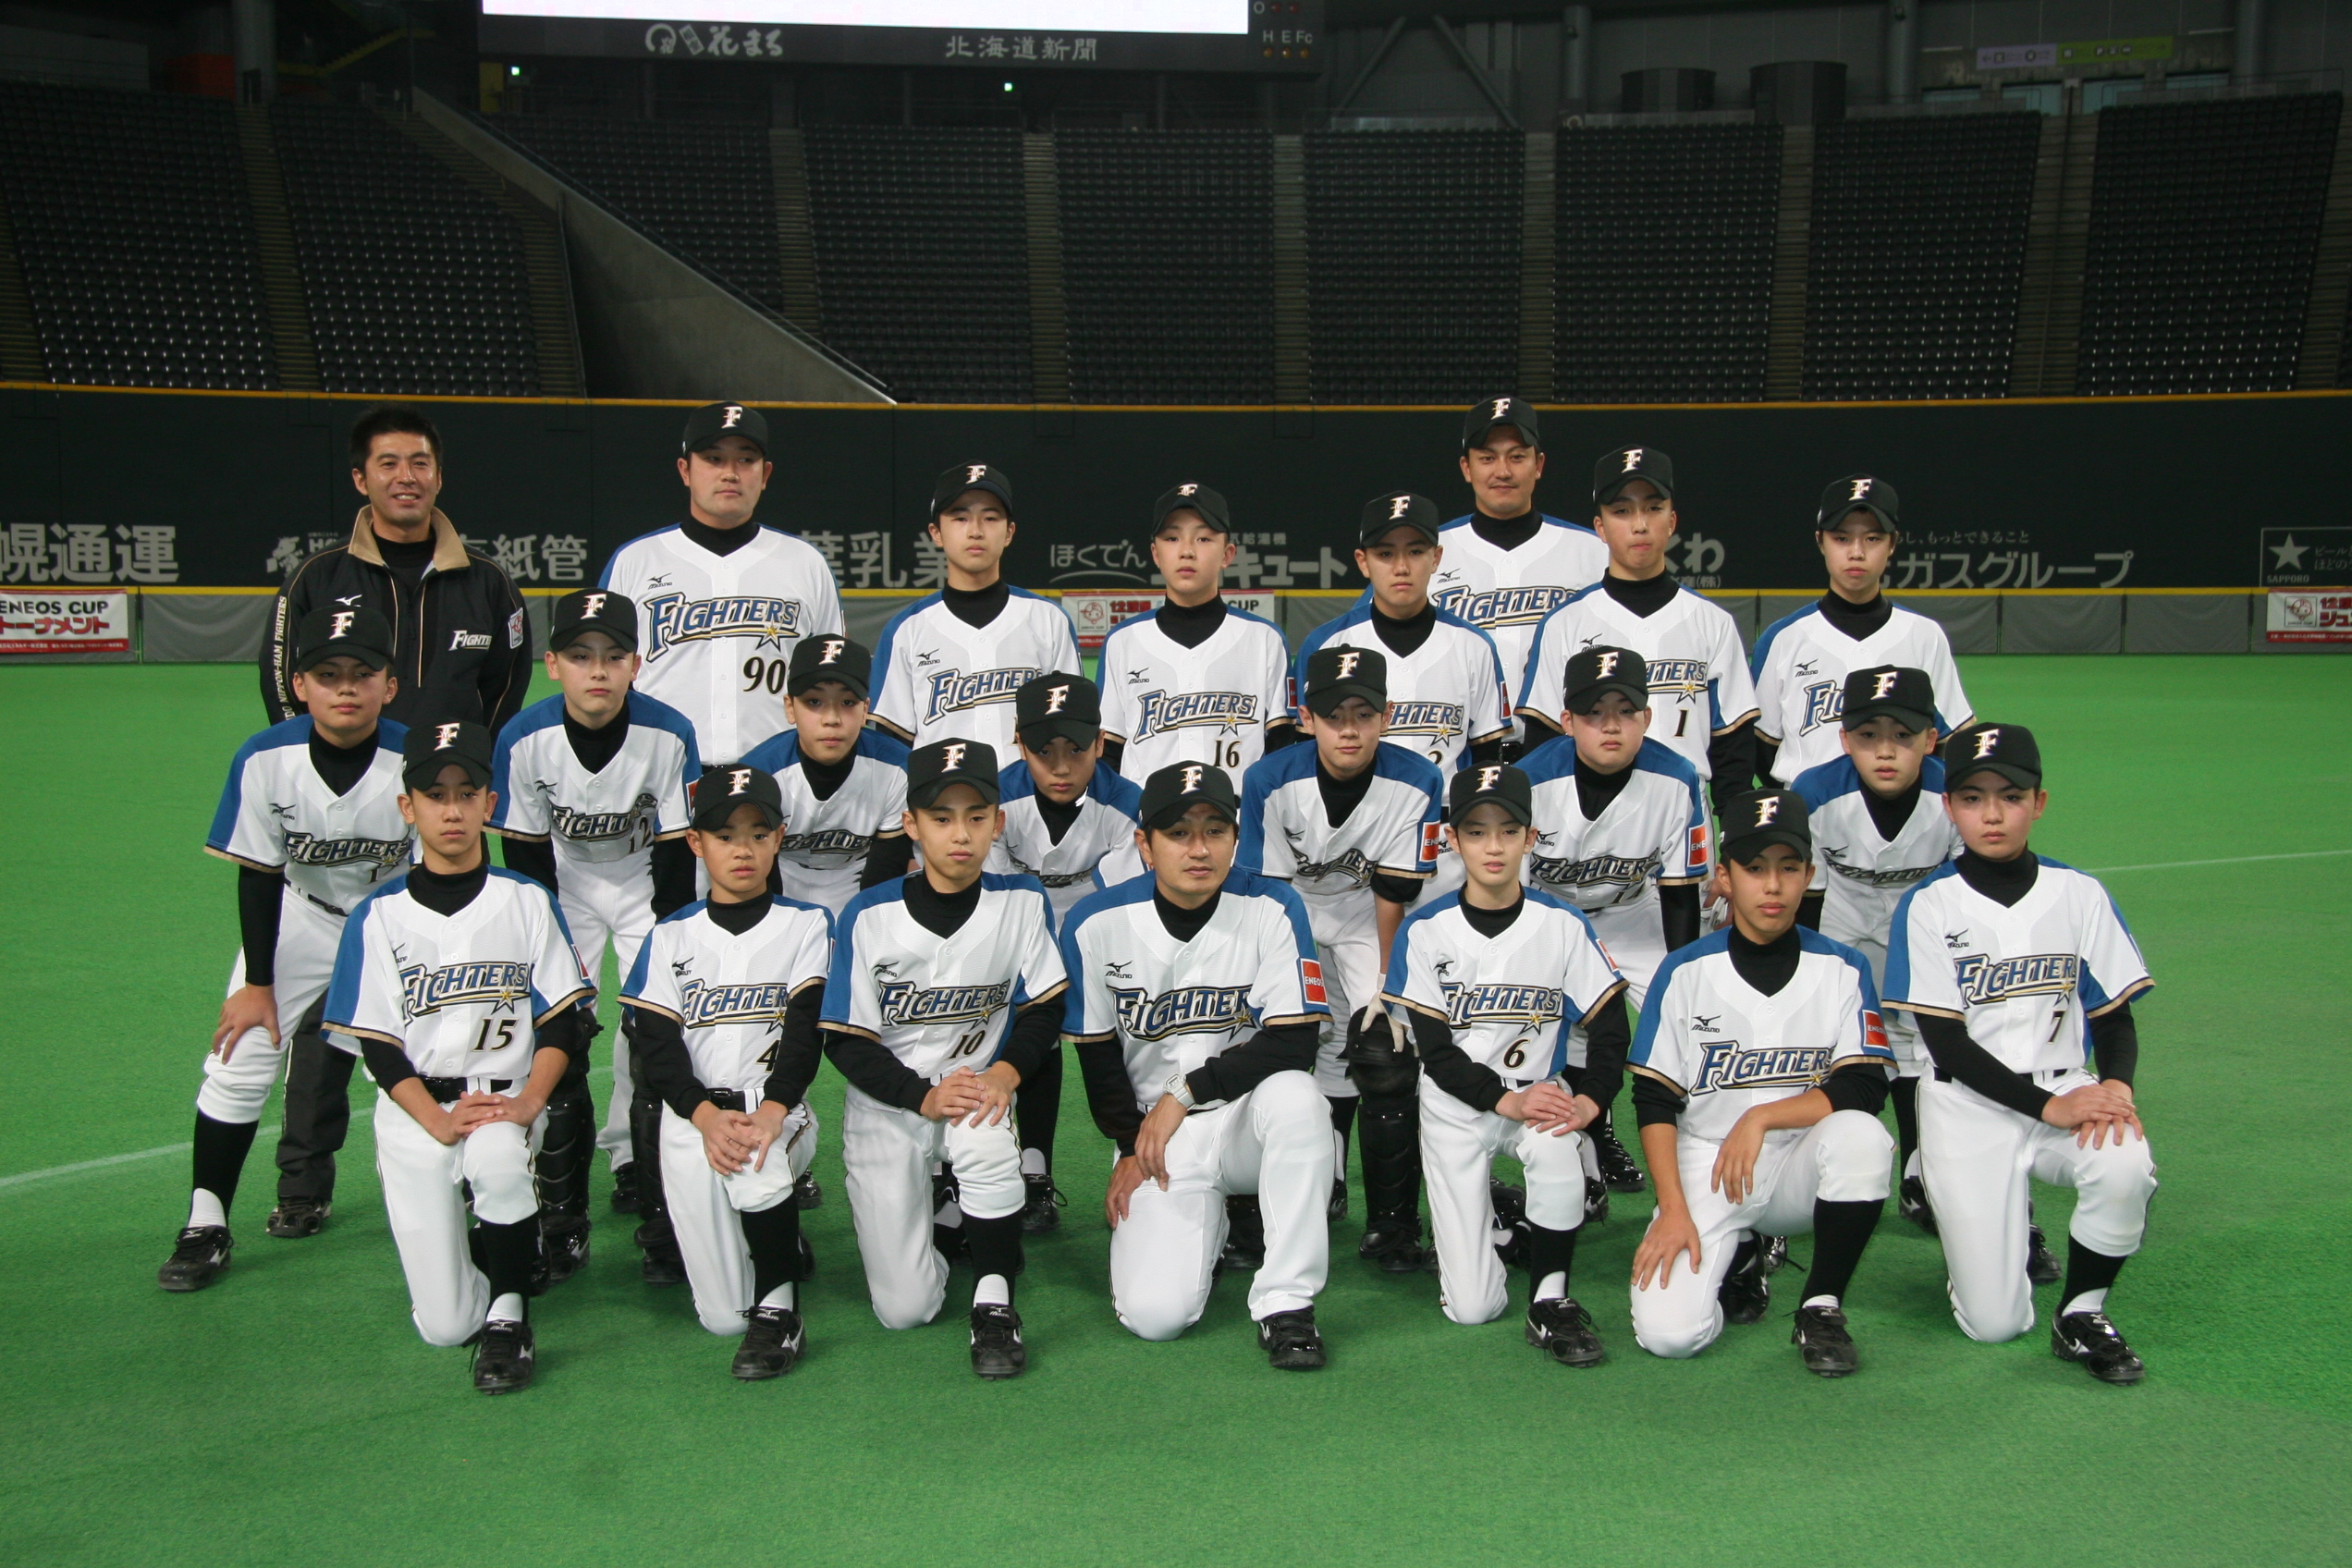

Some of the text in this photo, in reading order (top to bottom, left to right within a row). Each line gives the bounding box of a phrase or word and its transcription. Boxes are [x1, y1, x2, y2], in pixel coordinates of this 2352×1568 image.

[946, 35, 1097, 61] 北海道新聞
[1263, 30, 1273, 43] H
[1282, 30, 1292, 43] E
[721, 406, 742, 429] F
[1490, 398, 1511, 420] F
[966, 465, 986, 484] F
[1621, 448, 1643, 473] F
[1177, 483, 1198, 496] F
[1848, 478, 1872, 501] F
[1390, 496, 1411, 520] F
[0, 522, 179, 583] 幌通運
[1050, 539, 1146, 568] ほくでん
[2267, 575, 2309, 583] SAPPORO
[69, 601, 109, 615] CUP
[581, 594, 606, 619] F
[0, 616, 109, 635] トーナメント
[329, 611, 355, 640] F
[643, 592, 801, 663] FIGHTERS
[448, 630, 492, 651] FIGHT
[818, 640, 845, 665] F
[743, 655, 786, 695] 90
[1336, 652, 1360, 680] F
[1596, 651, 1619, 680] F
[1046, 684, 1070, 715] F
[1870, 671, 1897, 700] F
[1133, 689, 1257, 744] FIGHTERS
[1390, 702, 1464, 730] HTERS
[1672, 708, 1690, 738] 1
[434, 722, 460, 751] F
[1972, 729, 2000, 760] F
[941, 742, 966, 773] F
[1213, 740, 1242, 768] 16
[729, 768, 752, 796] F
[1181, 766, 1204, 794] F
[1476, 766, 1501, 792] F
[1754, 796, 1780, 827] F
[1954, 953, 2076, 1009] FIGHTER
[681, 978, 788, 1028] FIGHTER
[879, 979, 1011, 1026] FIGHTERS
[1108, 984, 1252, 1039] FIGHTER
[472, 1017, 520, 1052] 15
[1691, 1023, 1721, 1033] MIZUNO
[2046, 1008, 2067, 1045] 7
[755, 1037, 782, 1073] 4
[947, 1030, 986, 1060] 10
[1503, 1038, 1531, 1070] 6
